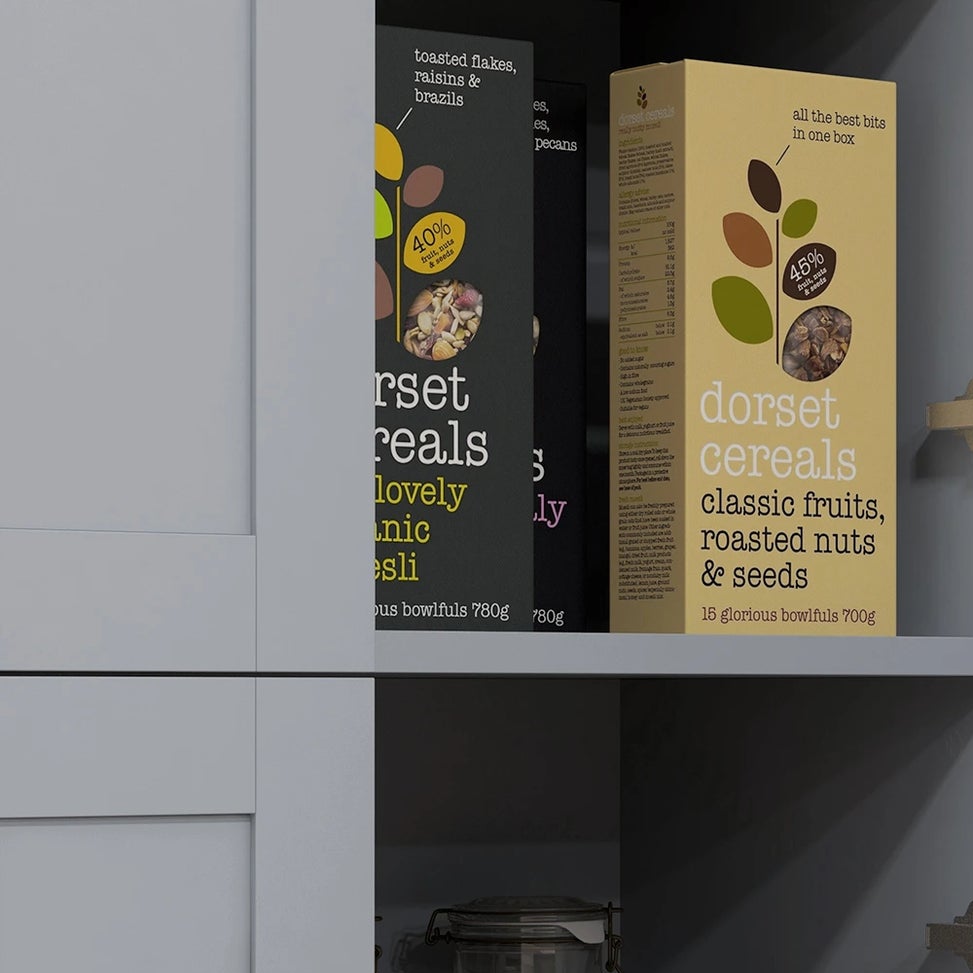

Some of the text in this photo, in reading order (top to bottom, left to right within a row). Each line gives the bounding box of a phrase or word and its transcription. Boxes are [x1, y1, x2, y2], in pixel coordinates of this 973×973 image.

[414, 48, 518, 74] toasted flakes,
[414, 69, 481, 88] raisins &
[415, 88, 464, 106] brazils
[792, 108, 886, 129] all the best bits
[534, 137, 578, 151] pecans
[792, 126, 855, 145] in one box
[413, 218, 452, 253] 40%
[438, 238, 455, 252] nuts
[435, 249, 455, 264] seeds
[790, 248, 825, 282] 45%
[700, 381, 840, 429] dorset
[700, 438, 857, 481] cereals
[375, 474, 468, 512] lovely
[533, 494, 568, 528] ly
[700, 488, 885, 525] classic fruits,
[700, 526, 876, 555] roasted nuts
[701, 559, 808, 589] & seeds
[401, 601, 468, 618] bowlfuls
[471, 603, 510, 622] 780g
[701, 606, 876, 626] 15 glorious bowlfuls 700g
